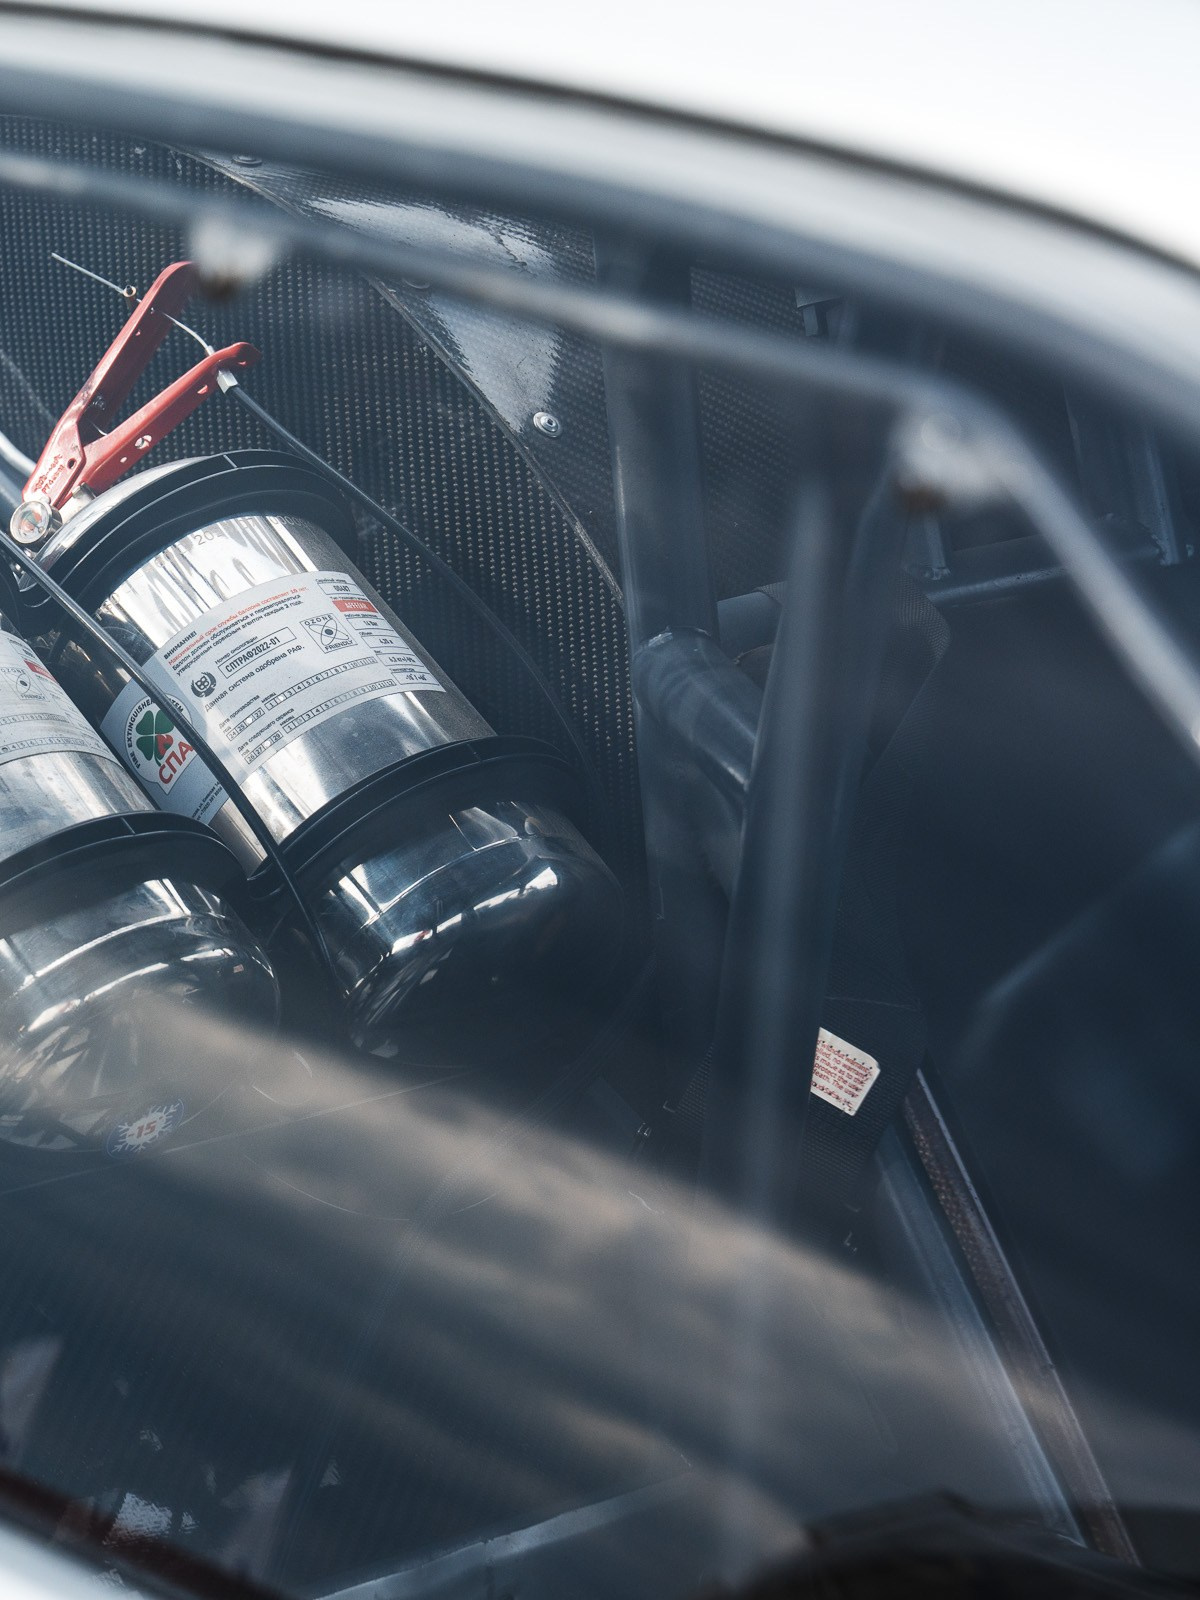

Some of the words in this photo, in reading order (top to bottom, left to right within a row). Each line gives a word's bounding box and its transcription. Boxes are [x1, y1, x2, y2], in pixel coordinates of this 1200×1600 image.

[205, 626, 217, 637] срок
[305, 614, 333, 626] OZONE
[164, 631, 197, 660] ВНИМАНИЕ!
[172, 655, 190, 671] Баллон
[191, 640, 210, 656] должен
[215, 652, 230, 665] Номер
[225, 636, 281, 673] СПТРАФ2022-01
[325, 639, 353, 651] FRIENDLY
[204, 690, 228, 712] Данная
[228, 671, 255, 692] система
[255, 652, 288, 673] одобрена
[287, 645, 305, 655] РАФ.
[127, 699, 155, 748] EXTINGUISHE
[130, 751, 141, 769] FIRE
[158, 741, 194, 785] СПА
